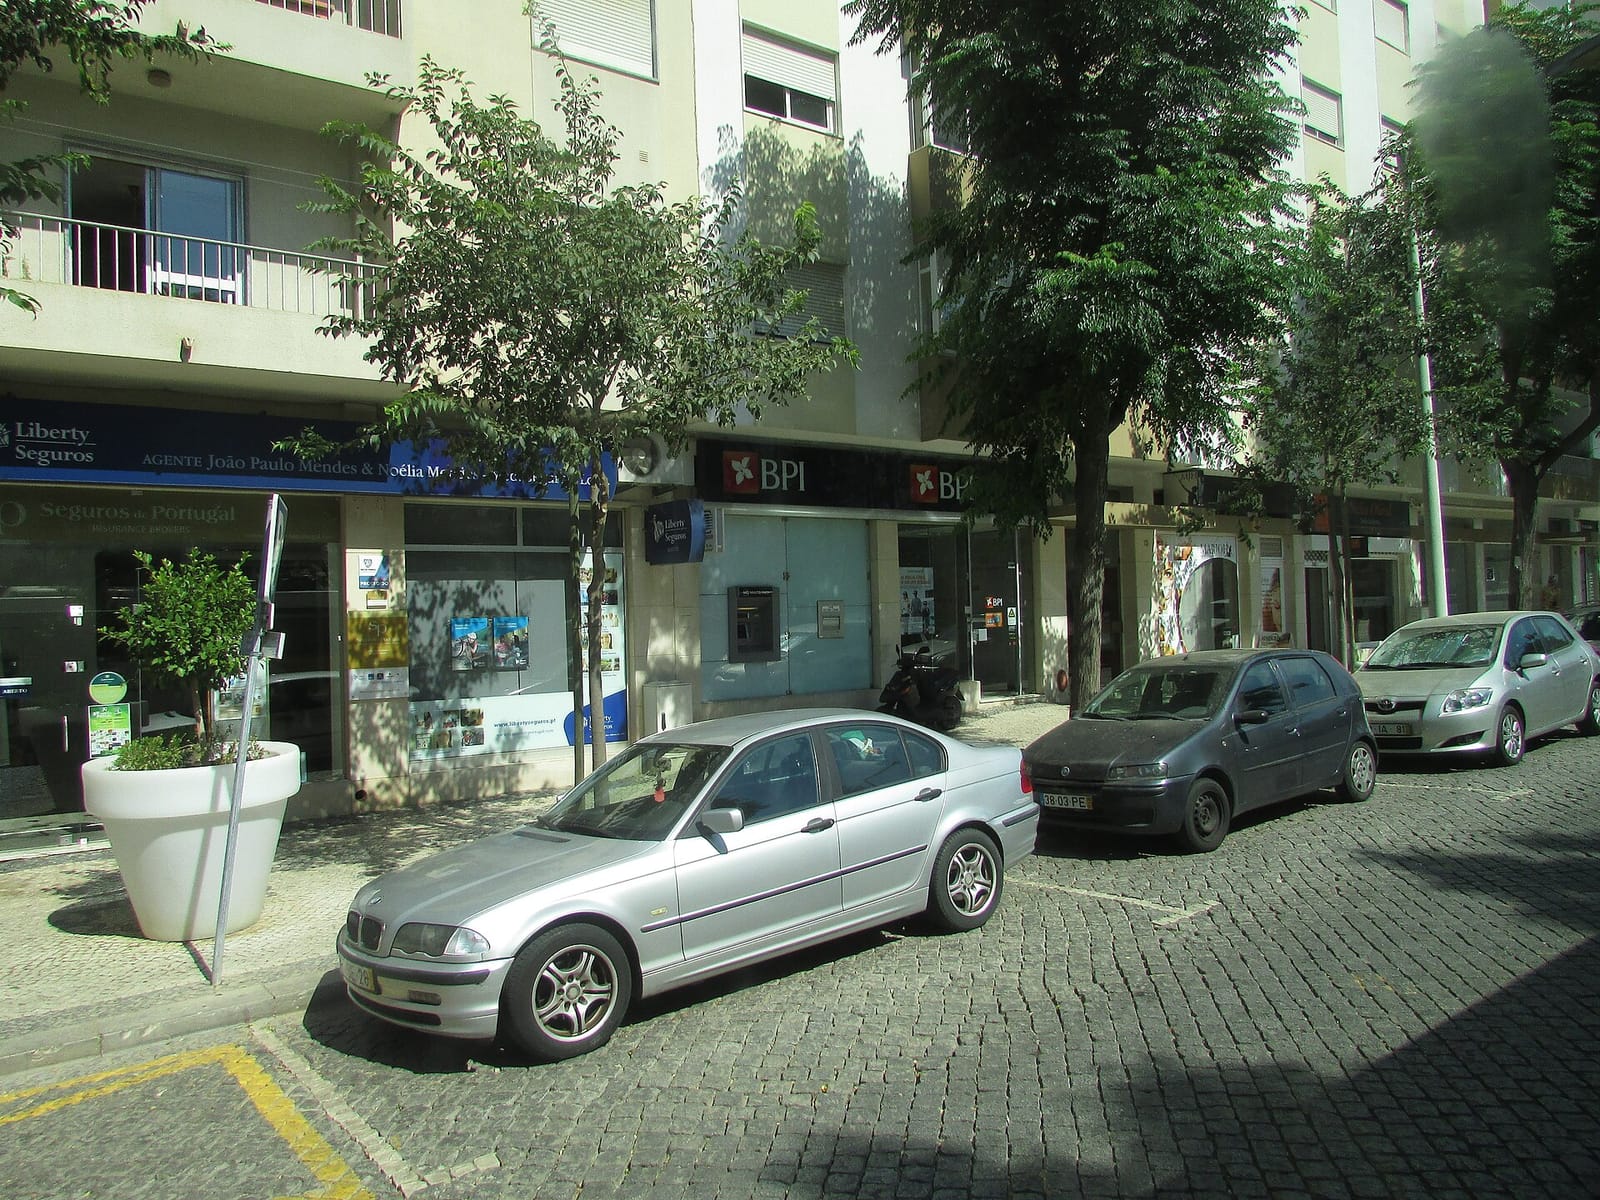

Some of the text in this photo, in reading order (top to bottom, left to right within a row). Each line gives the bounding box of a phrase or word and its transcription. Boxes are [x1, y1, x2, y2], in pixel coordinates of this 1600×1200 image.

[16, 422, 90, 446] Liberty
[15, 444, 94, 466] Seguros
[142, 453, 203, 468] AGENTE
[206, 454, 246, 471] João
[250, 456, 295, 472] Paulo
[299, 460, 358, 475] Mendes
[361, 463, 373, 475] &
[377, 462, 424, 478] Noélia
[760, 458, 806, 492] BPI
[39, 502, 130, 521] Seguros
[992, 597, 1003, 607] BPI
[1057, 796, 1069, 807] 03
[1071, 797, 1087, 808] PE
